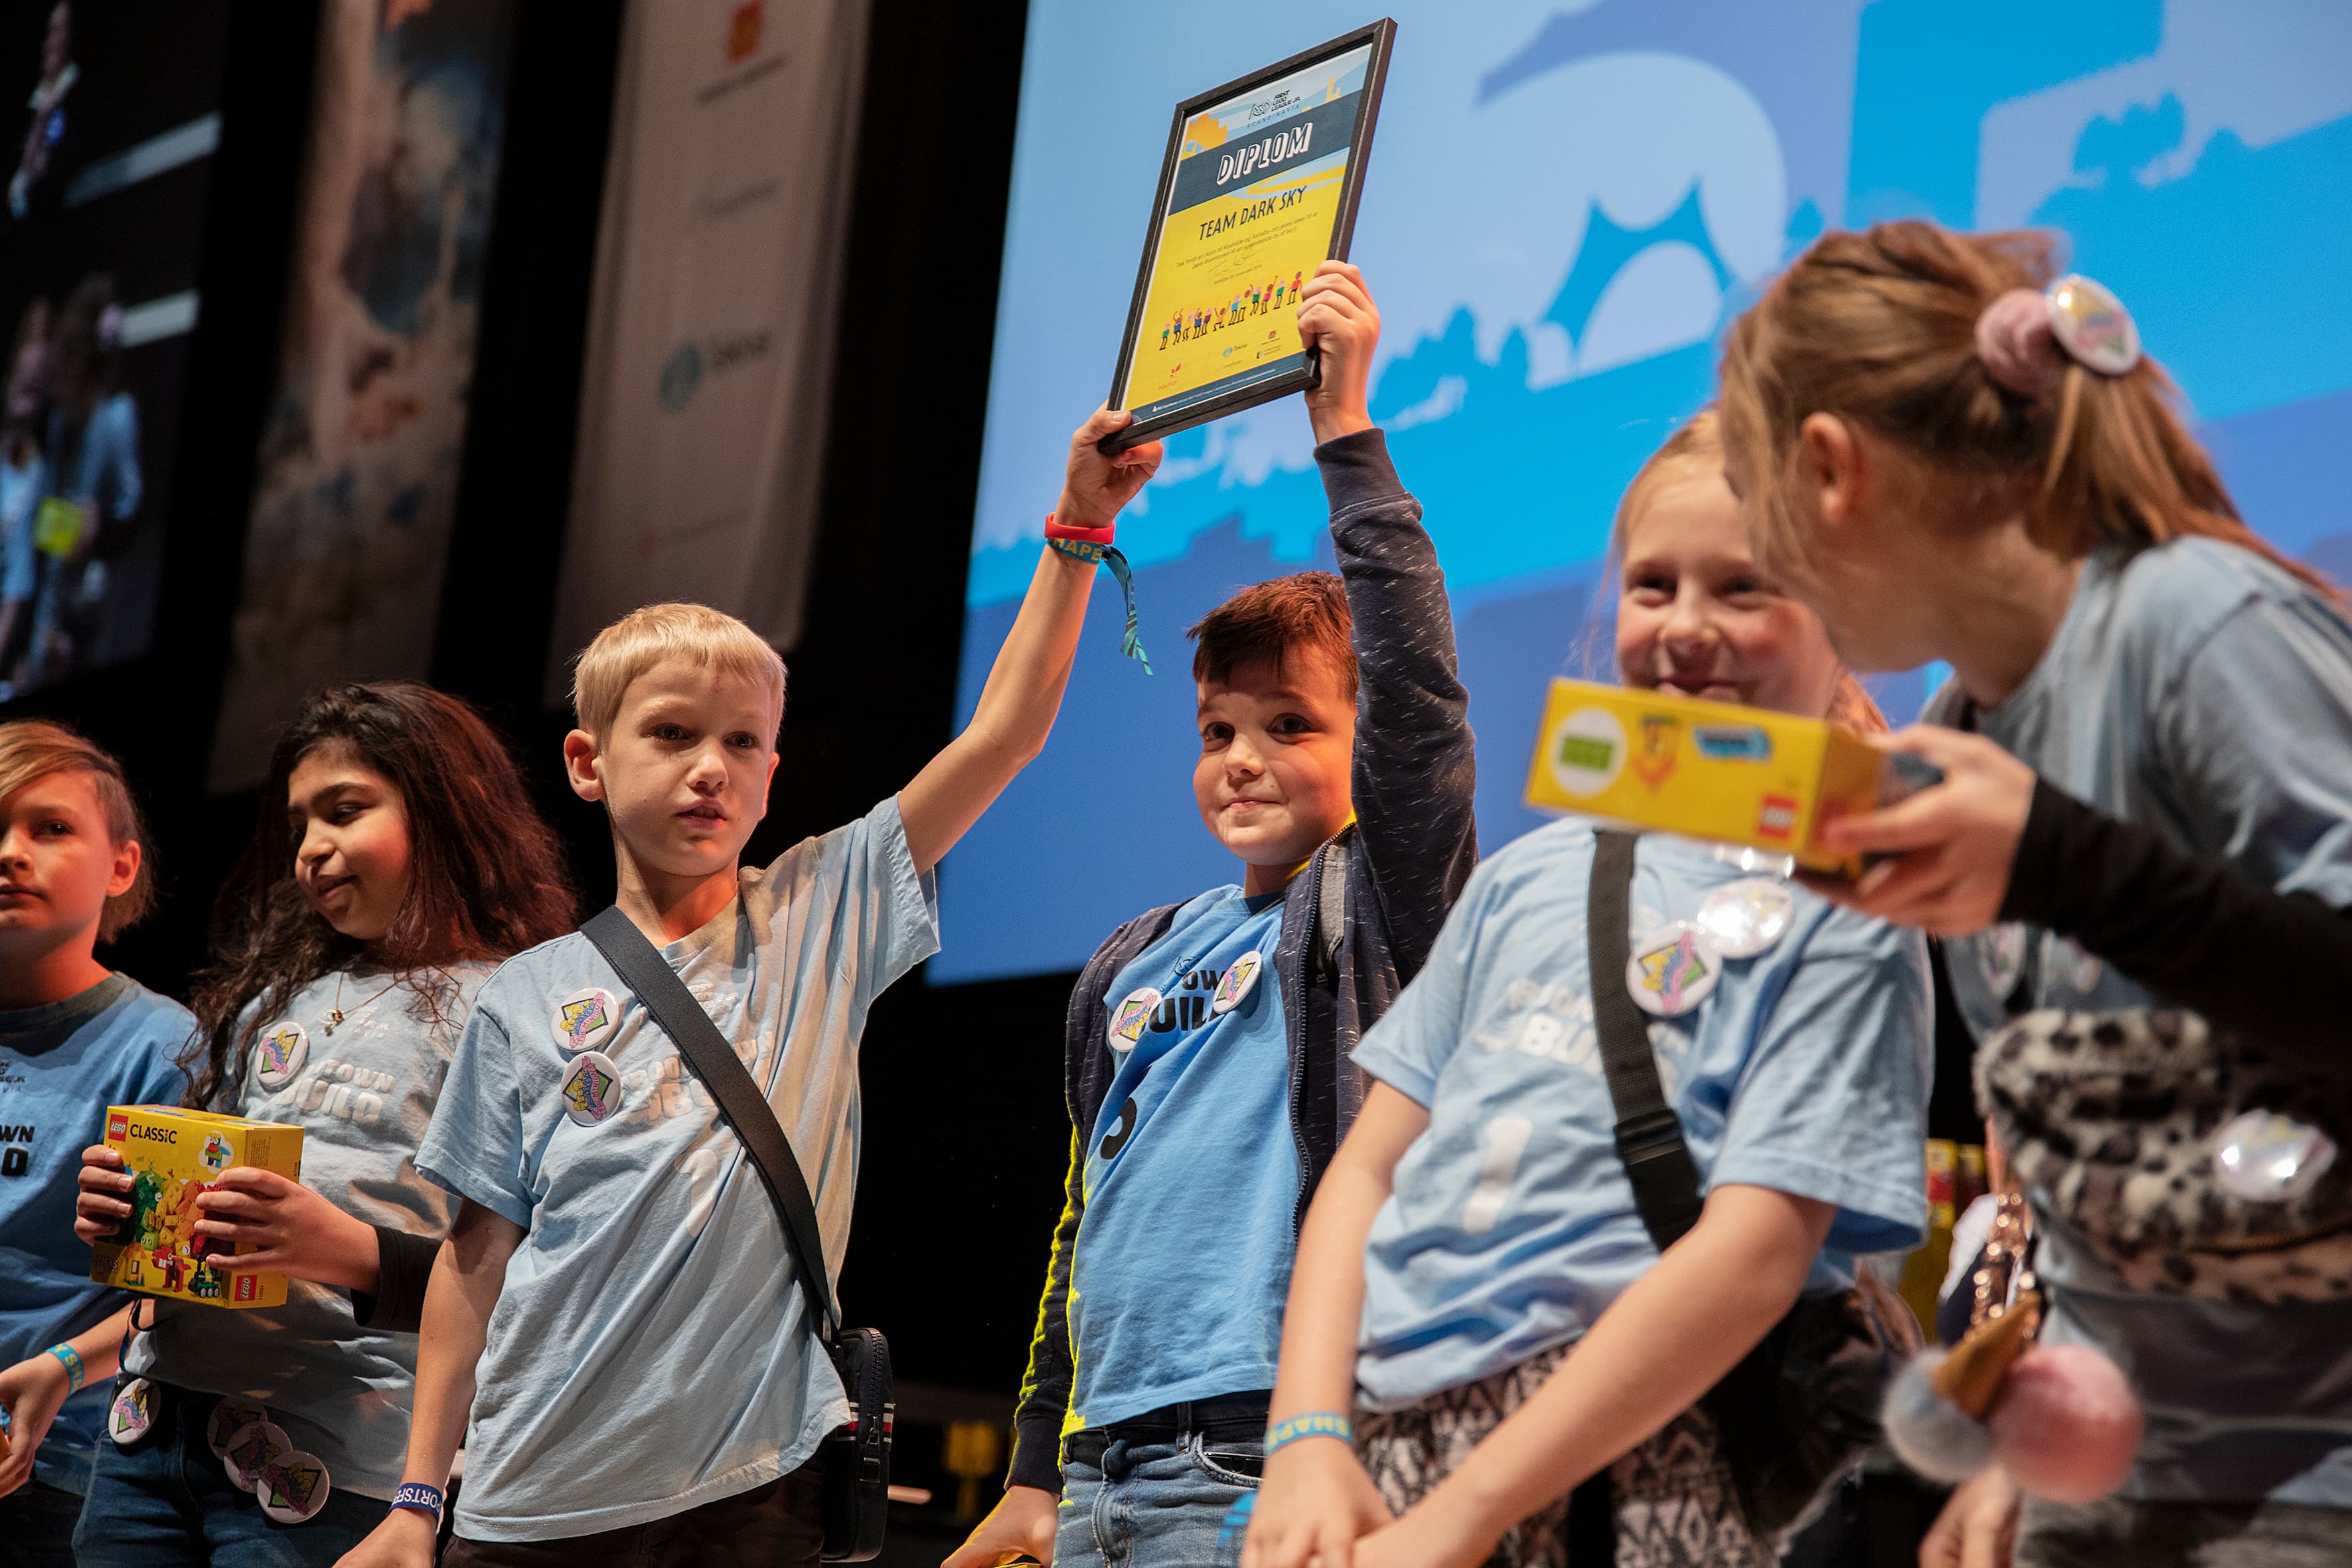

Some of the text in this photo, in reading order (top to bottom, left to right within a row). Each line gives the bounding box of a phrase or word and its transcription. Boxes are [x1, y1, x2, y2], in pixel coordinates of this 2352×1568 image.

[1216, 122, 1313, 186] DIPLOM
[1200, 185, 1307, 240] TEAM DARK SKY
[110, 1122, 126, 1133] LEGO
[242, 1277, 251, 1300] LEGO
